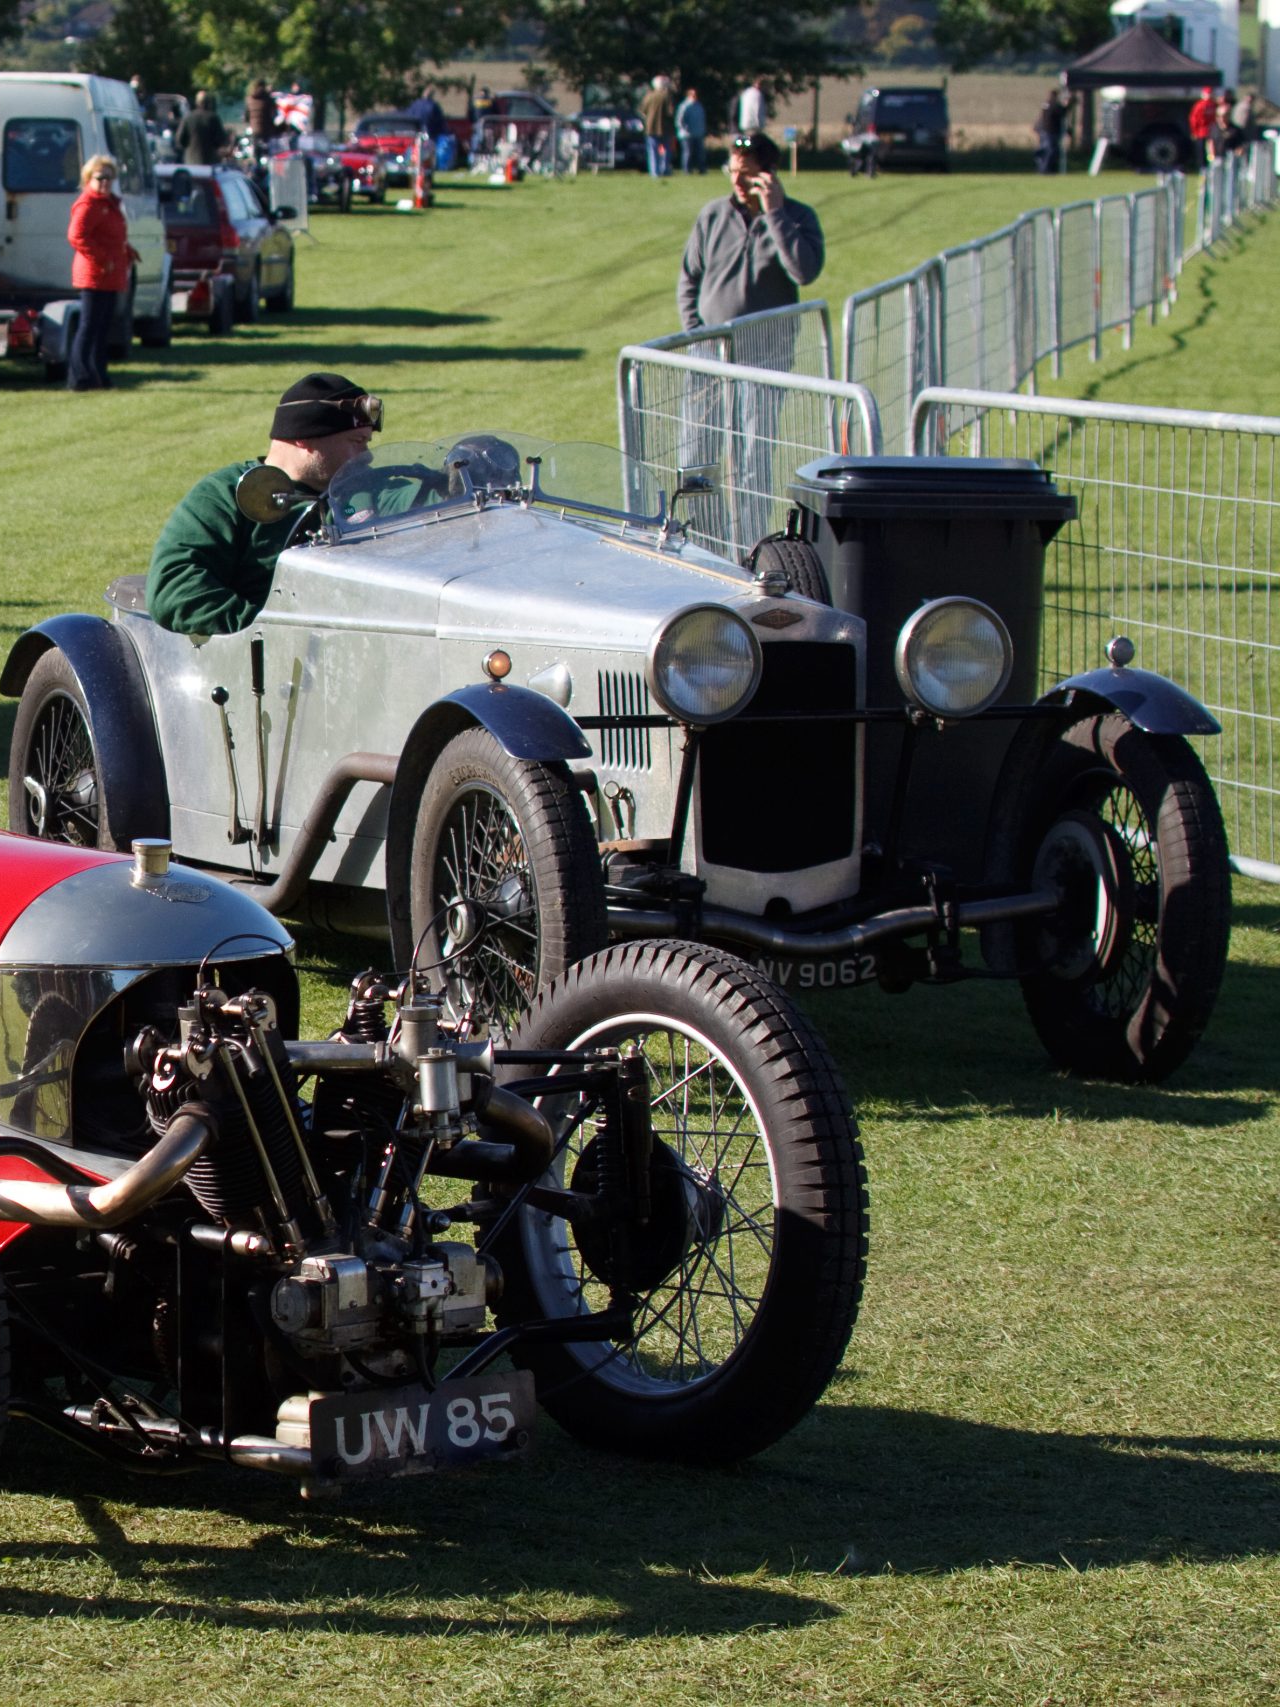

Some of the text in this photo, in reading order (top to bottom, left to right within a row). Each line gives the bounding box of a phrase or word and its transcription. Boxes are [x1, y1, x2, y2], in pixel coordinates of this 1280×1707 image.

[799, 955, 877, 988] 9062
[334, 1391, 517, 1466] UW 85
